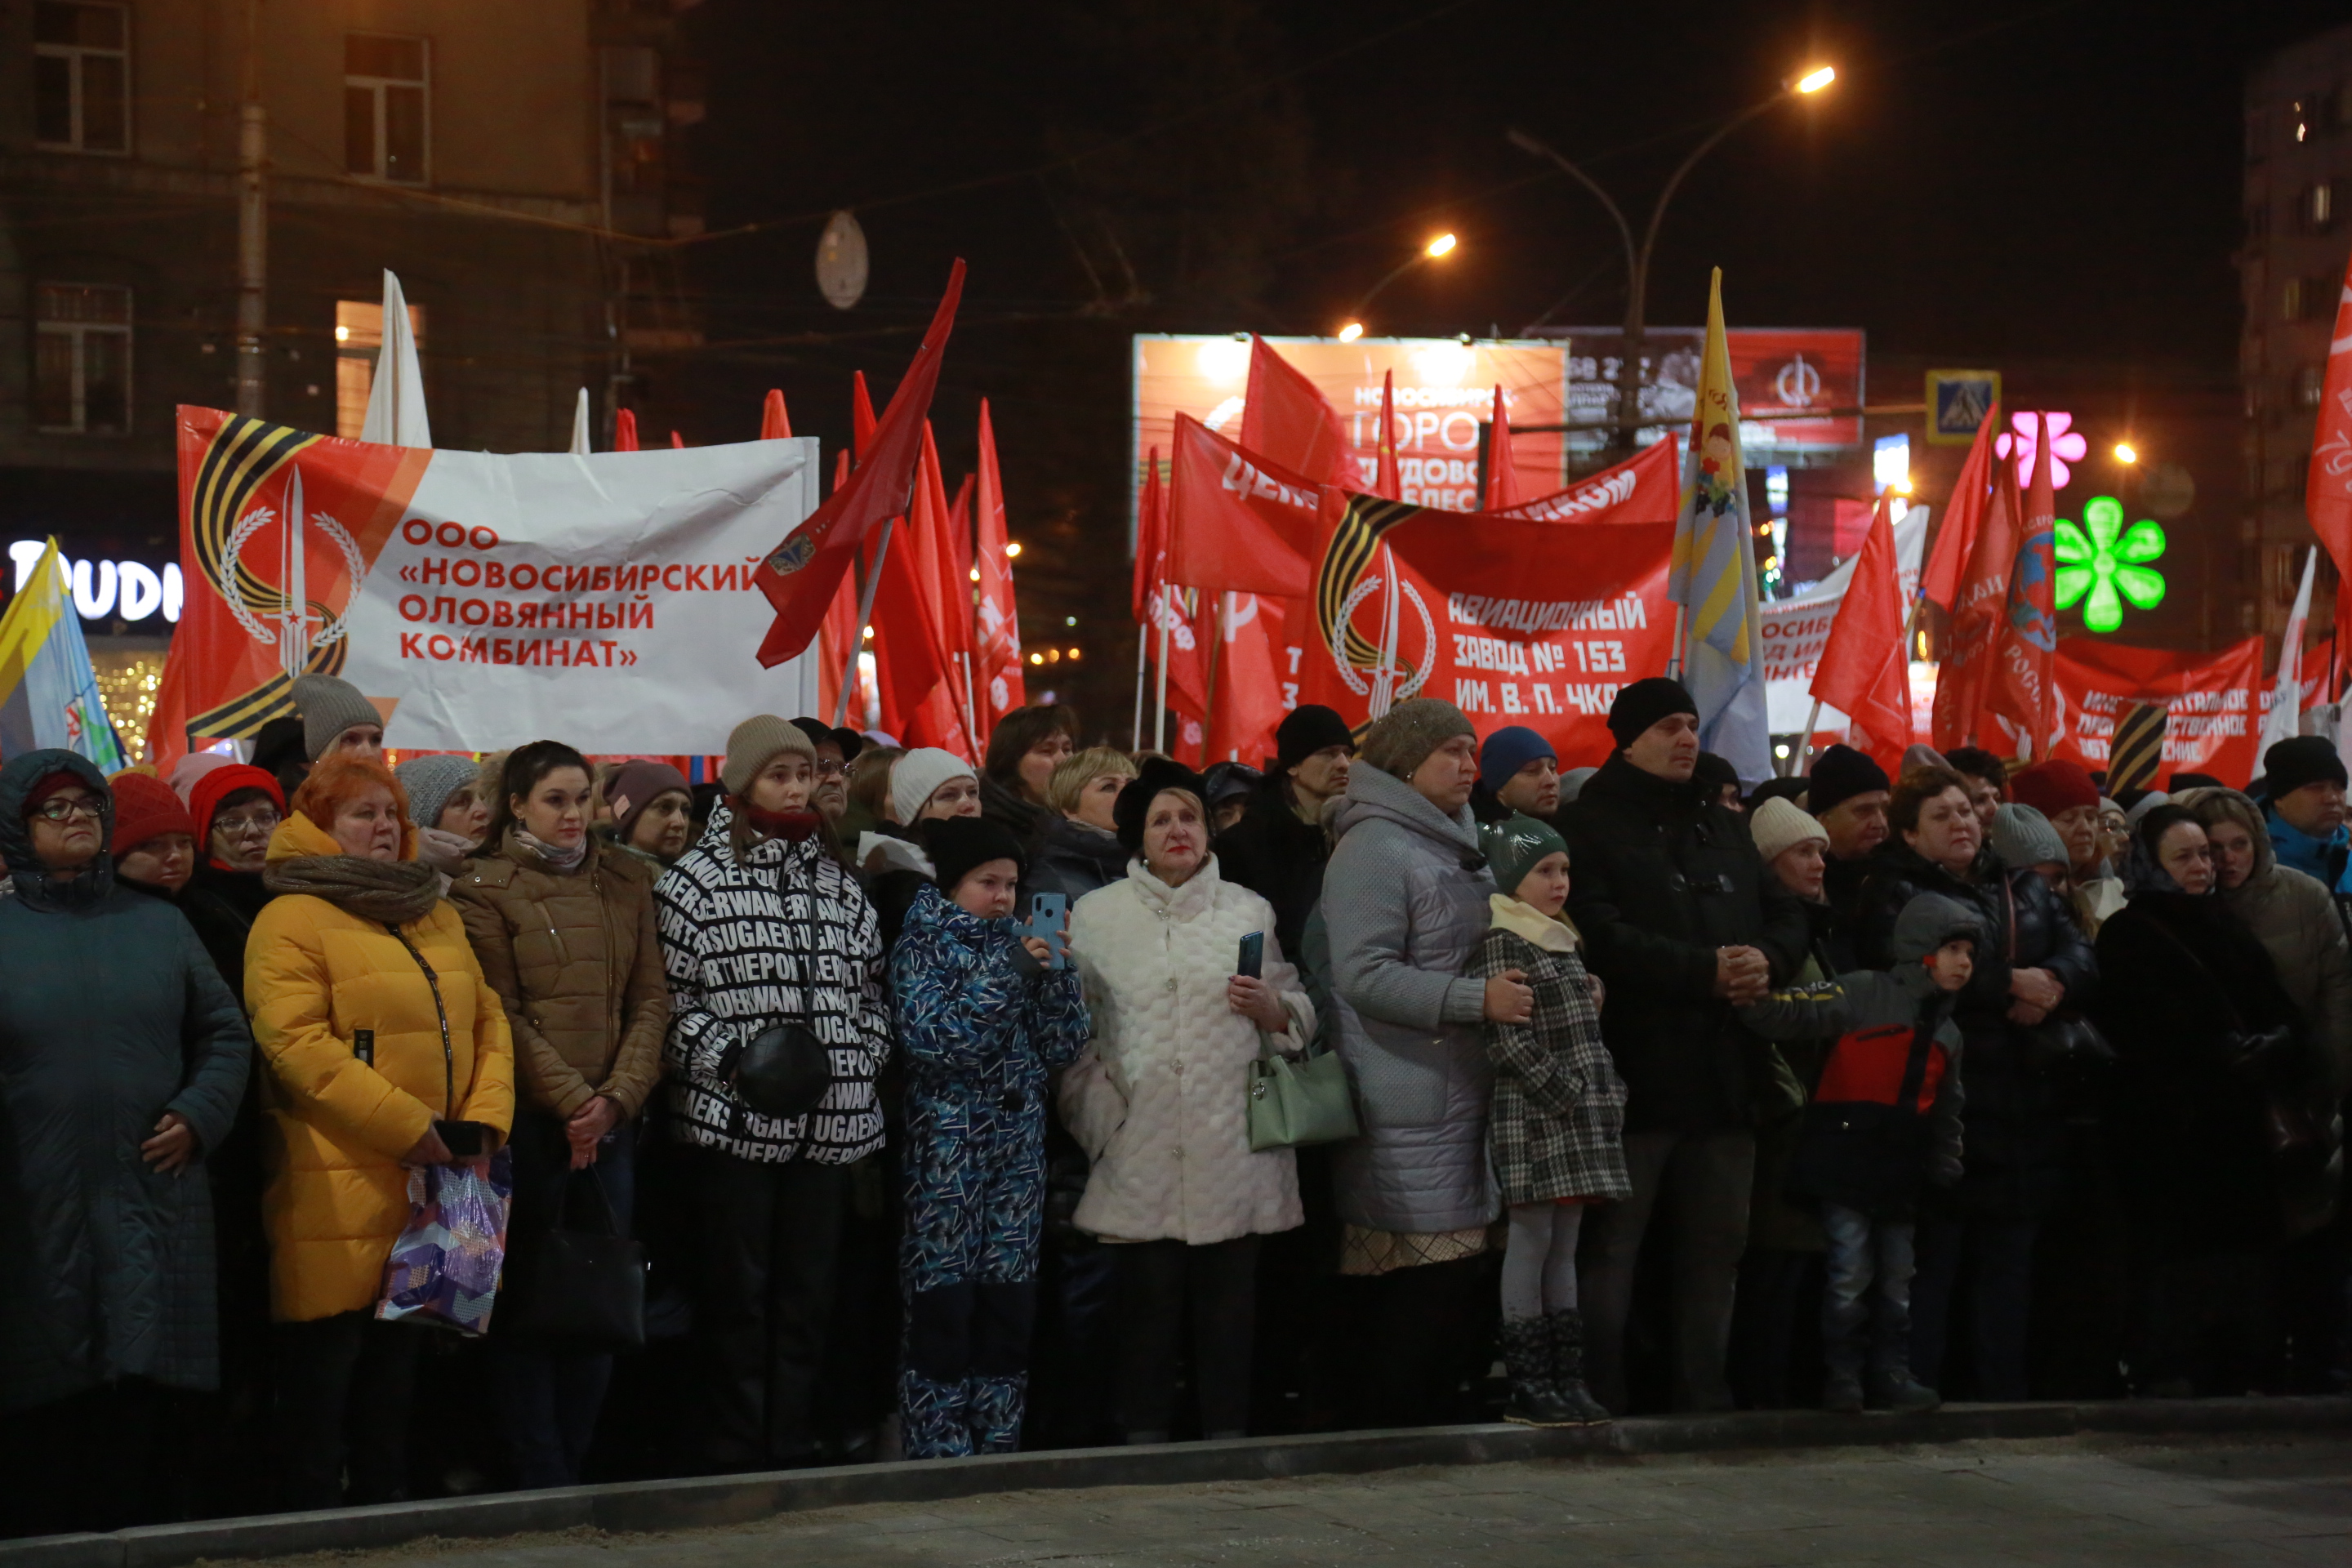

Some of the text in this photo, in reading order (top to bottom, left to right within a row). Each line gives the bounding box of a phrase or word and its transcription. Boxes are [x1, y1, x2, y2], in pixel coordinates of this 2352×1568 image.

[403, 518, 500, 550] ООО
[399, 593, 654, 629] ОЛОВЯННЫЙ
[1448, 590, 1647, 635] АВИАЦИОННЫЙ
[400, 631, 638, 667] КОМБИНАТ»
[1453, 633, 1627, 676] ЗАВОД № 153
[1455, 678, 1496, 714] ИМ.
[1500, 682, 1530, 715] В.
[1534, 683, 1563, 715] П.
